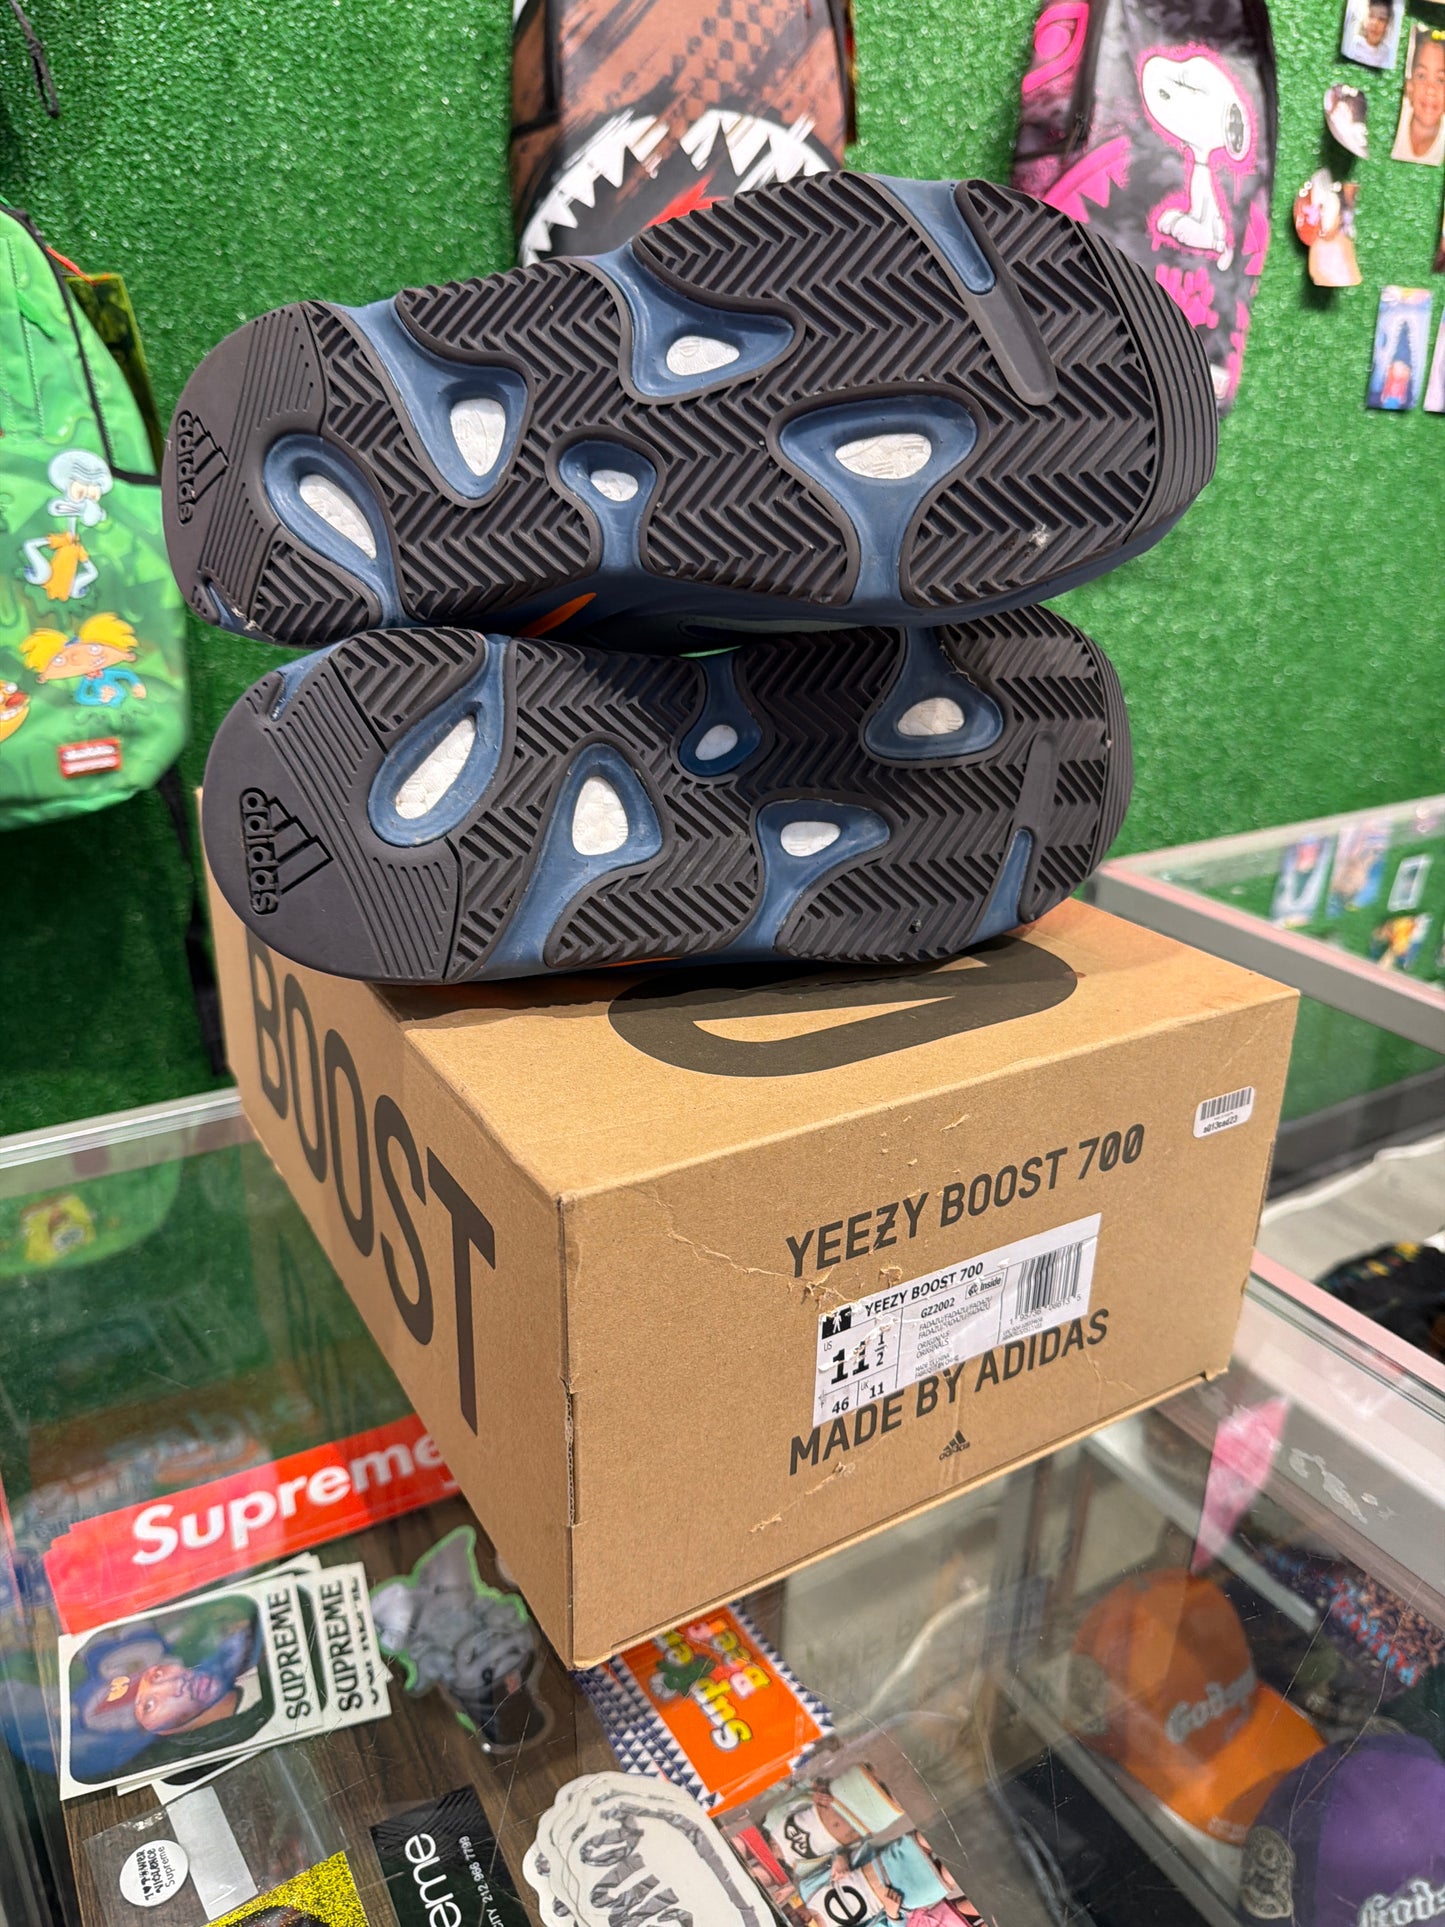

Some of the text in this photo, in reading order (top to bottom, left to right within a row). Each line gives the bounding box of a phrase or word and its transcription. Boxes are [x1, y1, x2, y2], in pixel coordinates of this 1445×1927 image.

[177, 409, 196, 525] adidas
[239, 786, 281, 917] adidas
[247, 926, 496, 1436] BOOST
[786, 1123, 1145, 1278] YEEZY BOOST 700
[864, 1262, 985, 1318] YEEZY BOOST 700
[920, 1297, 956, 1319] GZ2002
[823, 1340, 833, 1351] US
[790, 1308, 1110, 1476] MADE BY ADIDAS
[831, 1396, 850, 1414] 46
[869, 1383, 885, 1399] 11
[131, 1436, 443, 1567] Supreme
[266, 1587, 311, 1721] SUPREME
[320, 1581, 363, 1713] SUPREME
[158, 1846, 176, 1888] Supreme
[458, 1835, 475, 1861] 7799
[469, 1862, 484, 1882] 966
[477, 1883, 493, 1904] 212
